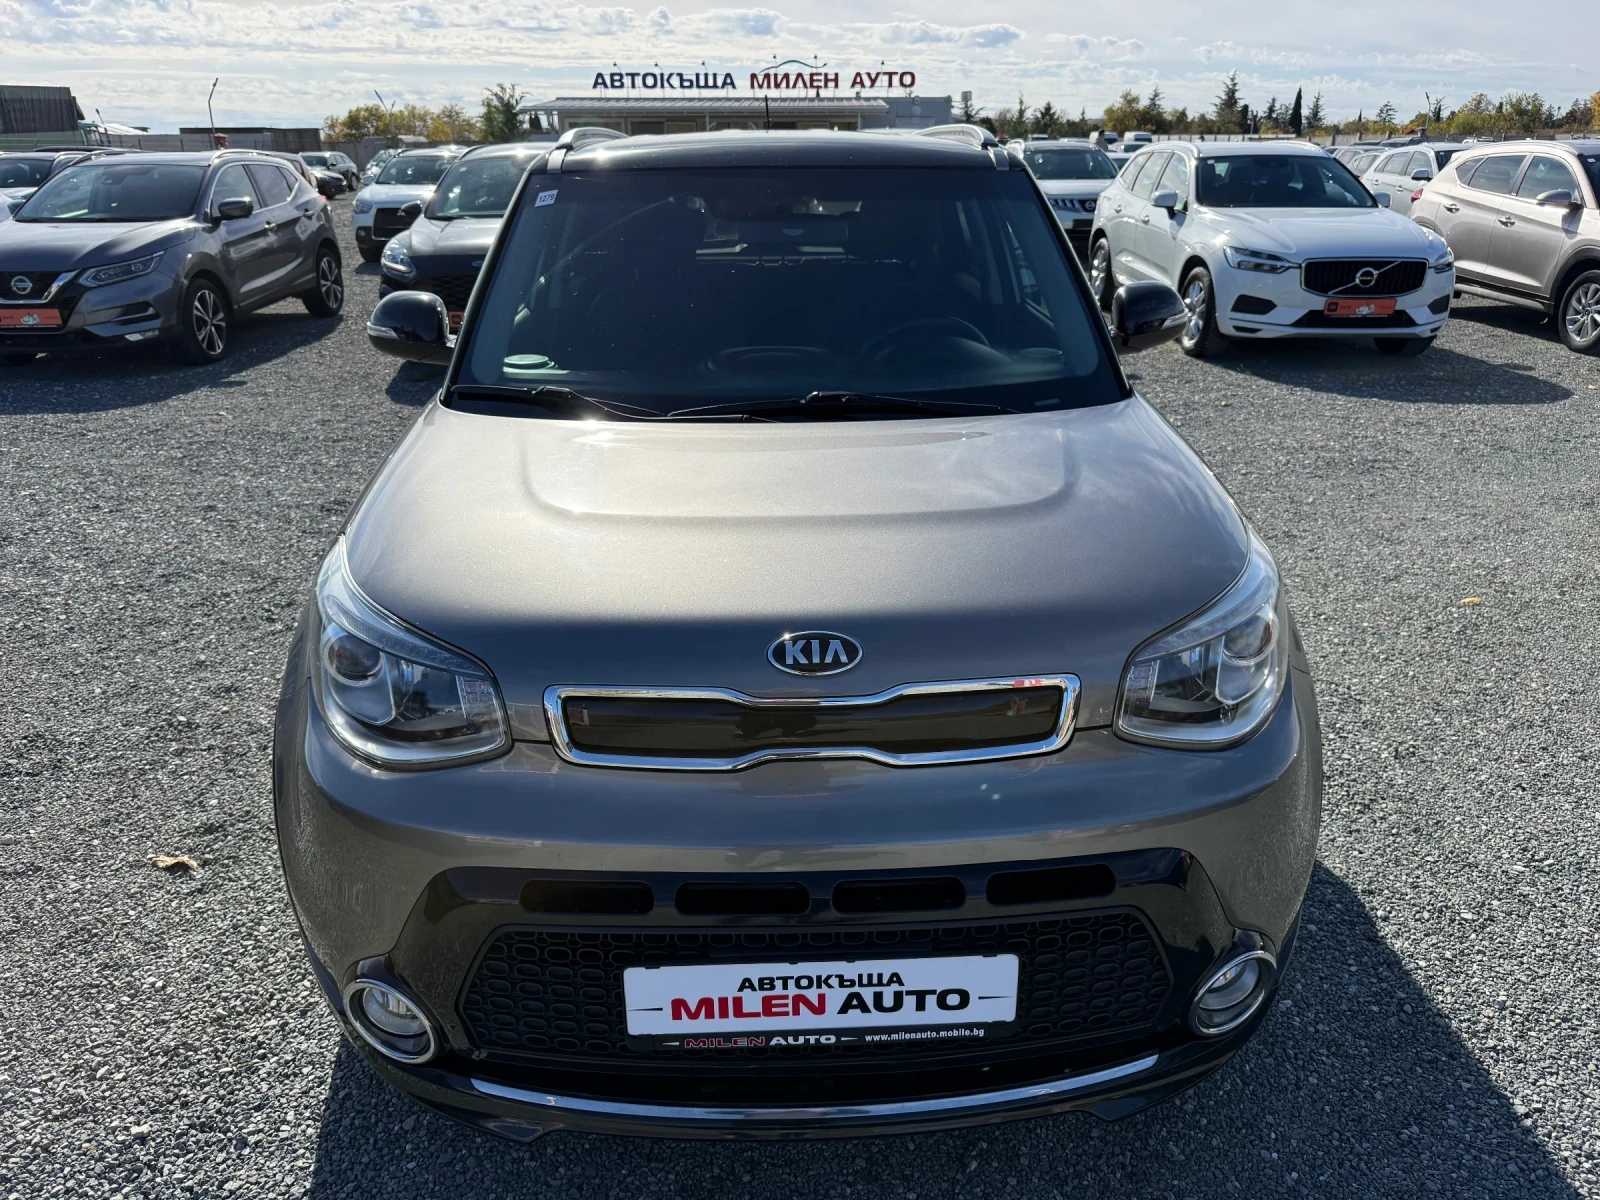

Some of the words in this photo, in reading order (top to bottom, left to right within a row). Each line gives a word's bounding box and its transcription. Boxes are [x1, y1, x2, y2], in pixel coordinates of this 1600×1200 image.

[750, 72, 839, 89] МИЛЕН
[850, 71, 916, 89] АУТО
[784, 640, 848, 665] KIA
[671, 993, 826, 1020] MILEN
[837, 988, 970, 1014] AUTO
[684, 1036, 765, 1048] MILEN
[769, 1034, 837, 1045] AUTO
[865, 1027, 985, 1042] www.milenauto.mobile.bg
